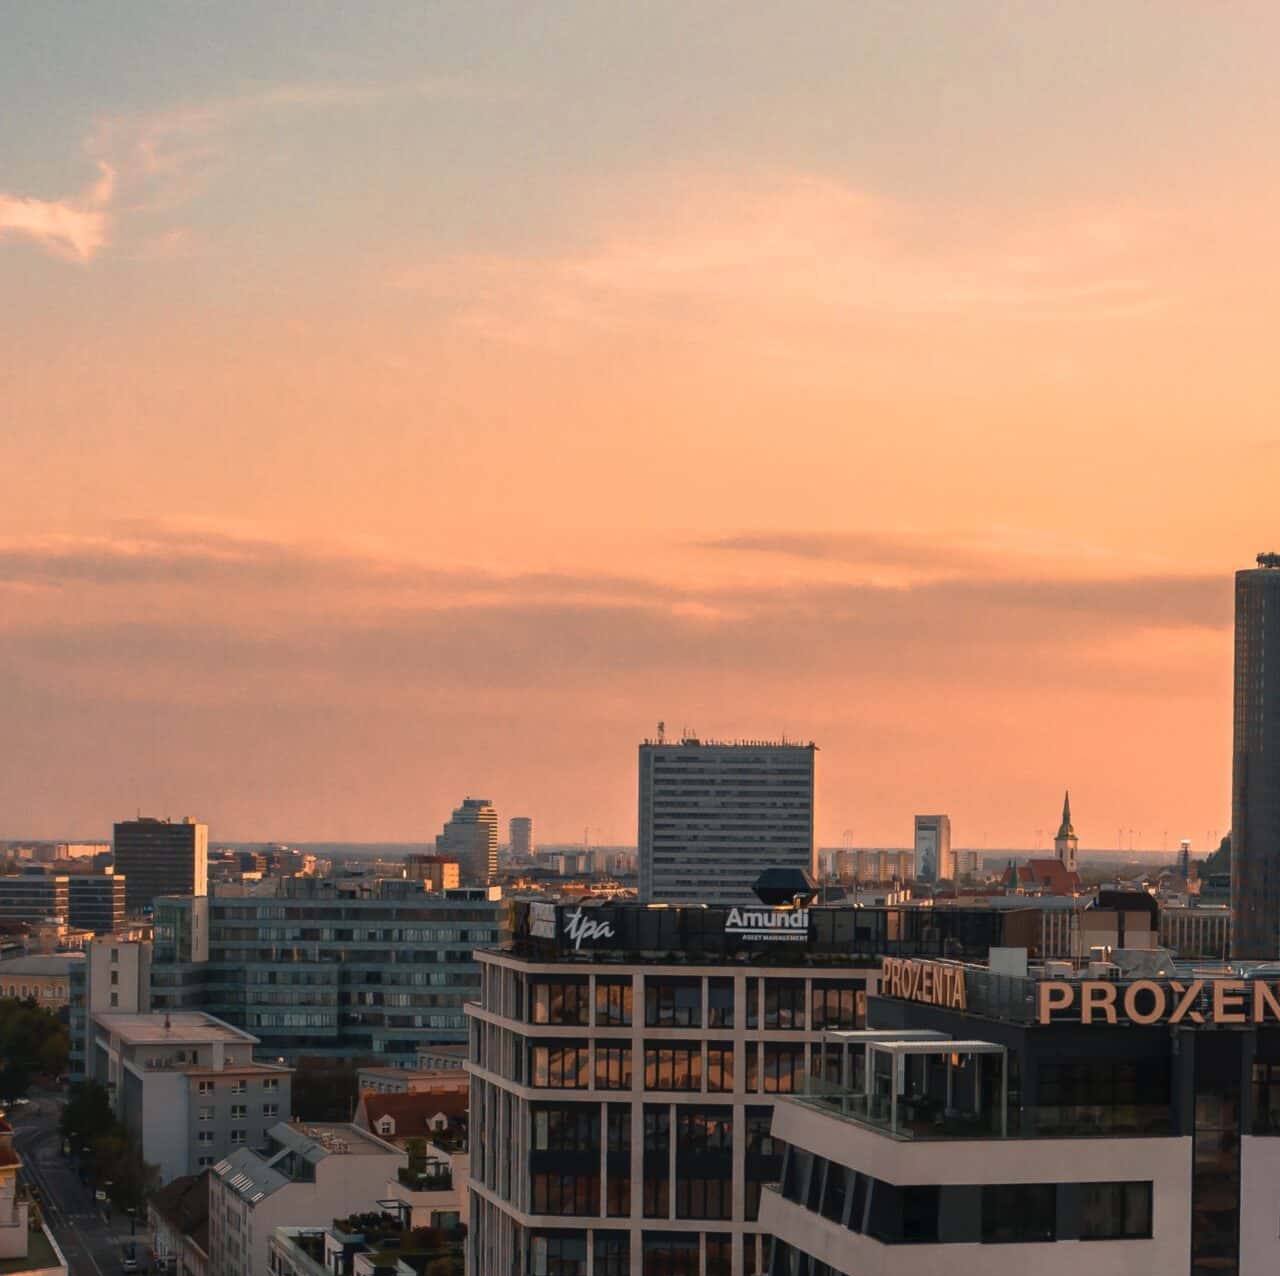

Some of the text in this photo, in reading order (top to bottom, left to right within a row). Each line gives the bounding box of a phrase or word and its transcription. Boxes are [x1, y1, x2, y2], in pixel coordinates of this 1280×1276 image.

[563, 906, 615, 950] tpa
[726, 908, 809, 927] Amundi
[882, 957, 967, 1008] PROXENTA
